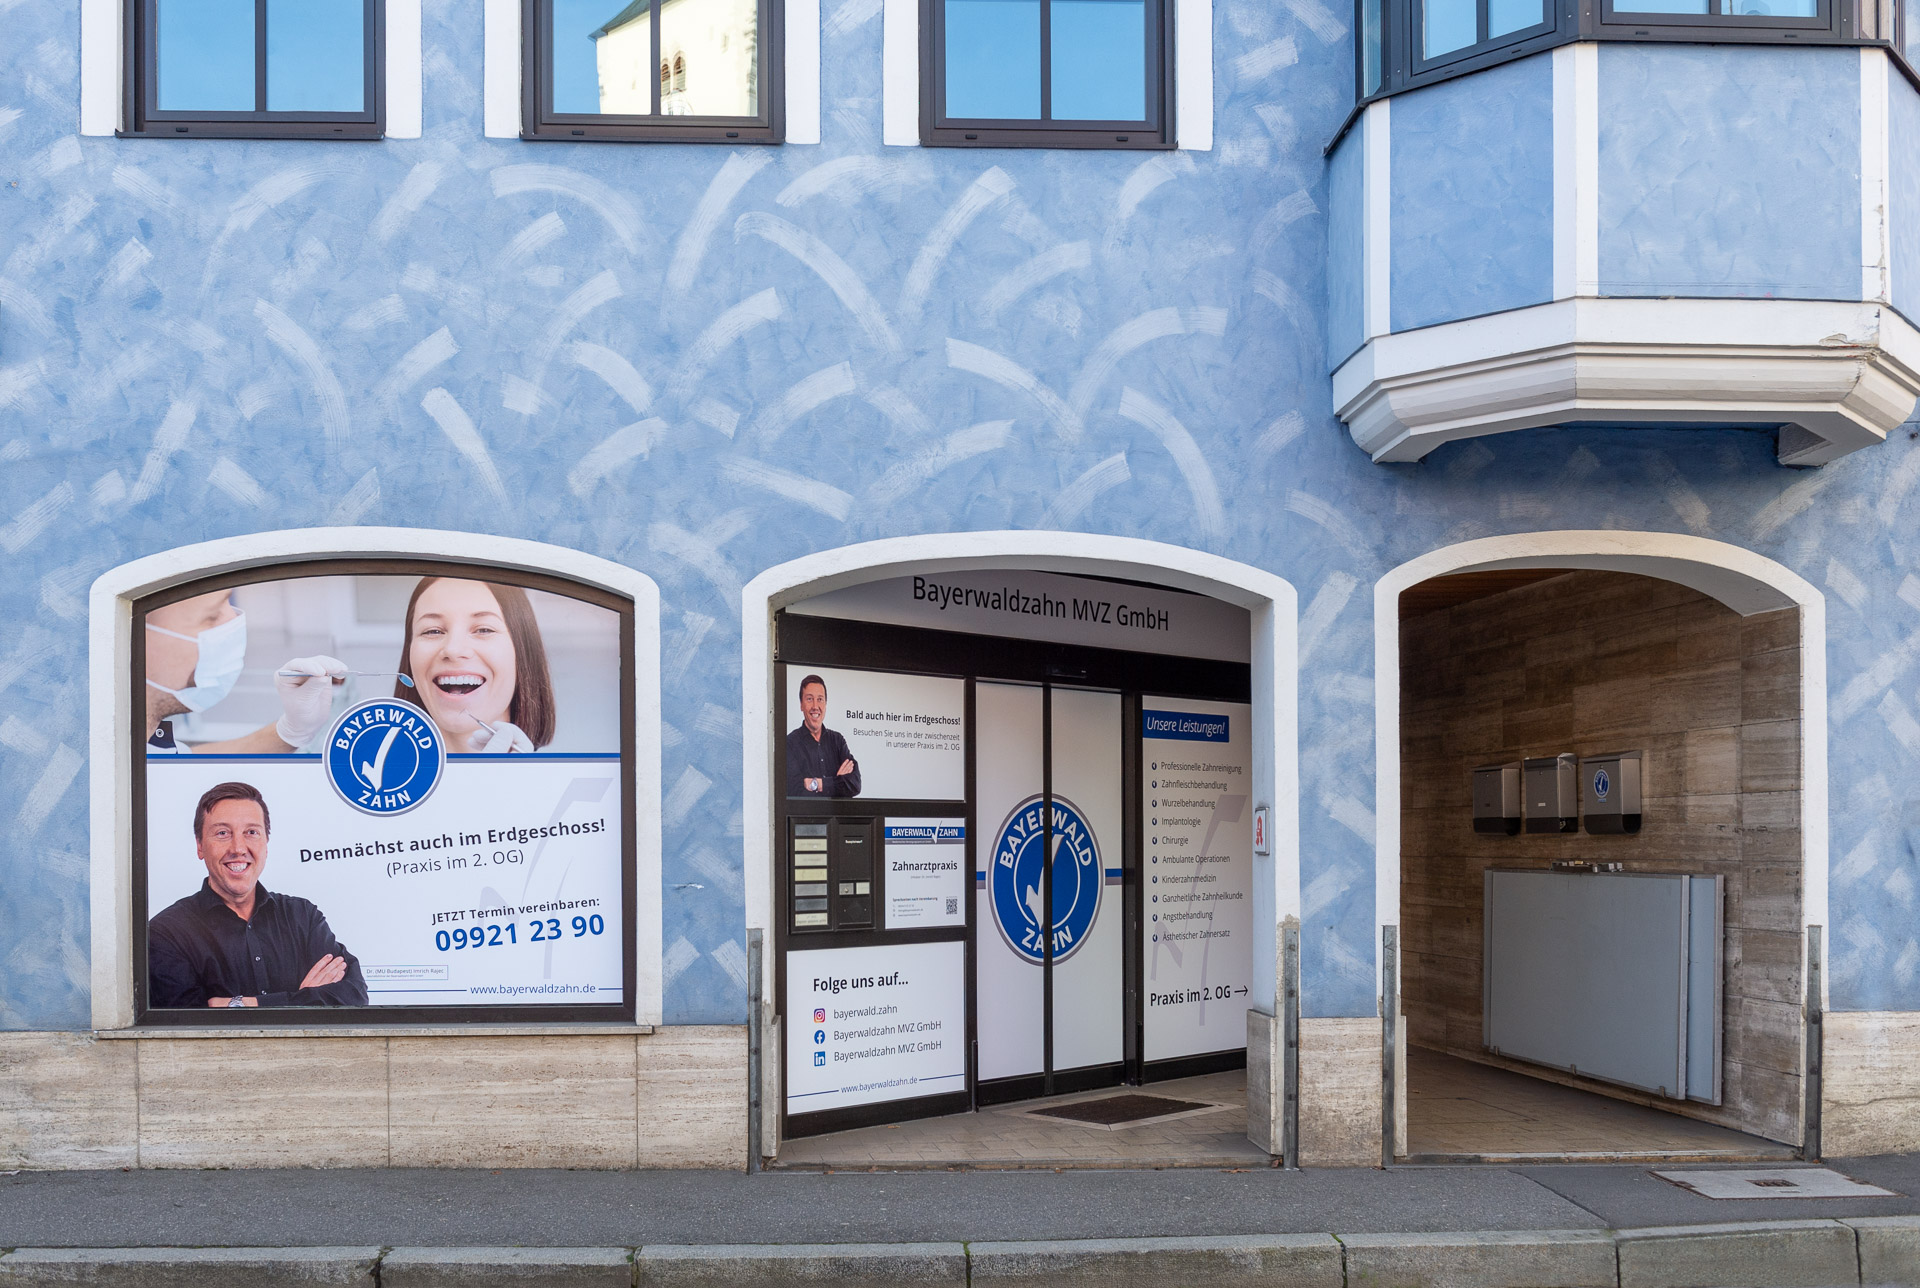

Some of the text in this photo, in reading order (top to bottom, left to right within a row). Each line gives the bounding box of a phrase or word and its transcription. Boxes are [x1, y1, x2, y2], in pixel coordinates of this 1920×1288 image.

[913, 576, 1169, 631] Bayerwaldzahn MVZ GmbH
[846, 710, 961, 726] Bald auch hier im Erdgeschoss!
[336, 709, 432, 750] BAYERWALD
[1147, 717, 1225, 737] Unsere Leistungen!
[853, 728, 883, 737] Besuchen
[884, 729, 893, 738] Sie
[907, 730, 912, 738] in
[914, 730, 923, 739] der
[924, 731, 960, 741] zwischenzeit
[886, 740, 960, 751] in unserer Praxis im 2. OG
[1161, 762, 1242, 775] Professionelle Zahnreinigung
[1161, 780, 1227, 791] Zahnfleischbehandlung
[358, 790, 411, 808] ZAHN
[1162, 799, 1215, 809] Wurzelbehandlung
[1162, 817, 1201, 827] Implantologie
[892, 828, 958, 837] BAYERWALD ZAHN
[300, 819, 606, 863] Demnächst auch im Erdgeschoss!
[1162, 836, 1188, 846] Chirurgie
[387, 849, 524, 878] (Praxis im 2. OG)
[1162, 855, 1230, 864] Ambulante Operationen
[892, 861, 958, 873] Zahnarztpraxis
[1162, 874, 1216, 884] Kinderzahnmedizin
[1162, 891, 1243, 903] Ganzheitliche Zahnheilkunde
[432, 898, 600, 926] JETZT Termin vereinbaren:
[1162, 911, 1213, 923] Angstbehandlung
[435, 913, 605, 951] 09921 23 90
[1162, 929, 1230, 942] Ästhetischer Zahnersatz
[470, 984, 596, 996] www.bayerwaldzahn.de
[813, 972, 909, 994] Folge uns auf...
[1150, 985, 1231, 1007] Praxis im 2. OG
[833, 1004, 898, 1020] bayerwald.zahn
[833, 1020, 942, 1042] Bayerwaldzahn MVZ GmbH
[834, 1040, 942, 1063] Bayerwaldzahn MVZ GmbH
[841, 1077, 918, 1094] www.bayerwaldzahn.de
